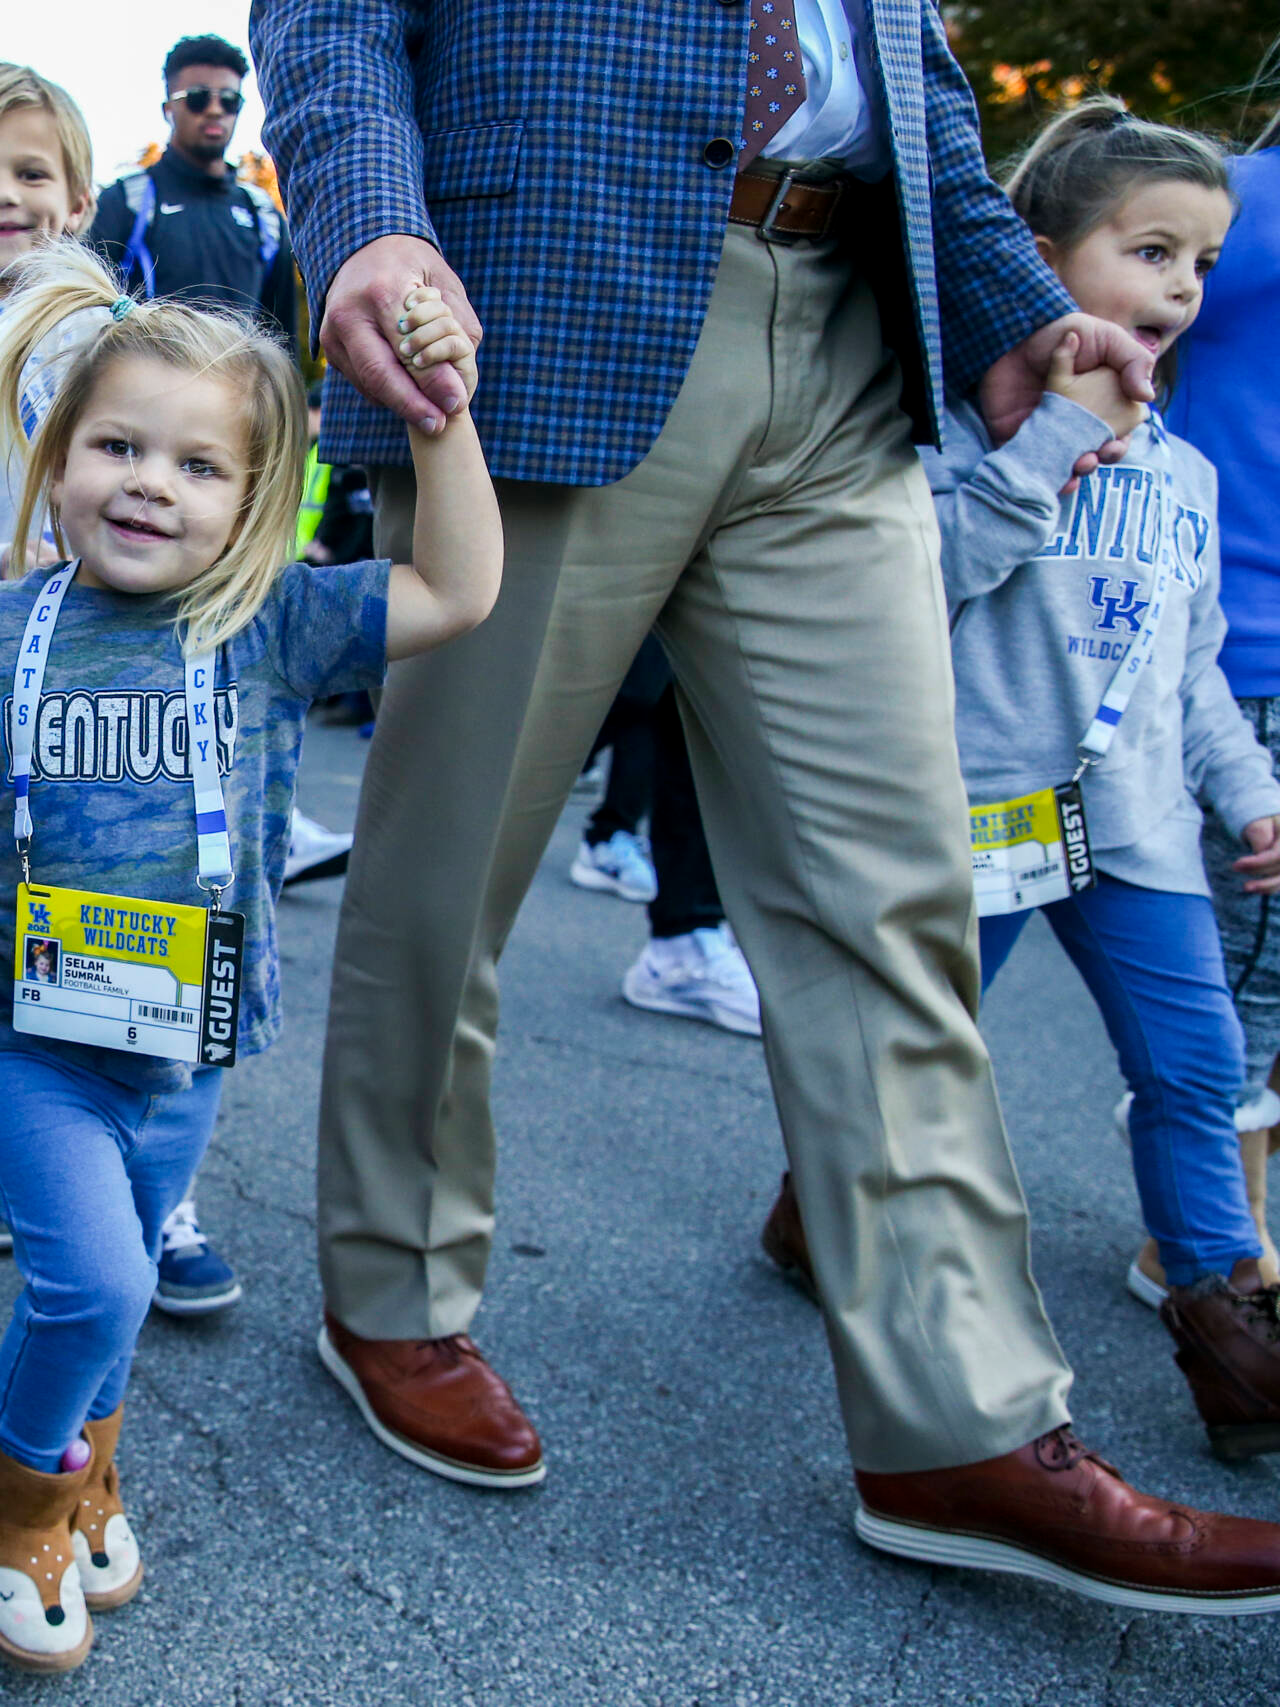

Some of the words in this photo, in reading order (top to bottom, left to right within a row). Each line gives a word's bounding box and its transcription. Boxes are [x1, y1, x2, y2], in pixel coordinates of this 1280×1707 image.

[1090, 576, 1150, 634] UK
[2, 681, 238, 784] ENTUCY
[1061, 802, 1091, 875] GUEST
[28, 902, 52, 925] UK
[80, 904, 176, 936] KENTUCKY
[27, 923, 51, 934] 2021
[83, 927, 169, 958] WILDCATS
[65, 957, 105, 972] SELAH
[64, 969, 113, 985] SUMRALL
[64, 979, 102, 992] FOOTBALL
[103, 984, 130, 996] FAMILY
[22, 987, 41, 1002] FB
[208, 939, 236, 1041] GUEST
[127, 1026, 137, 1040] 6
